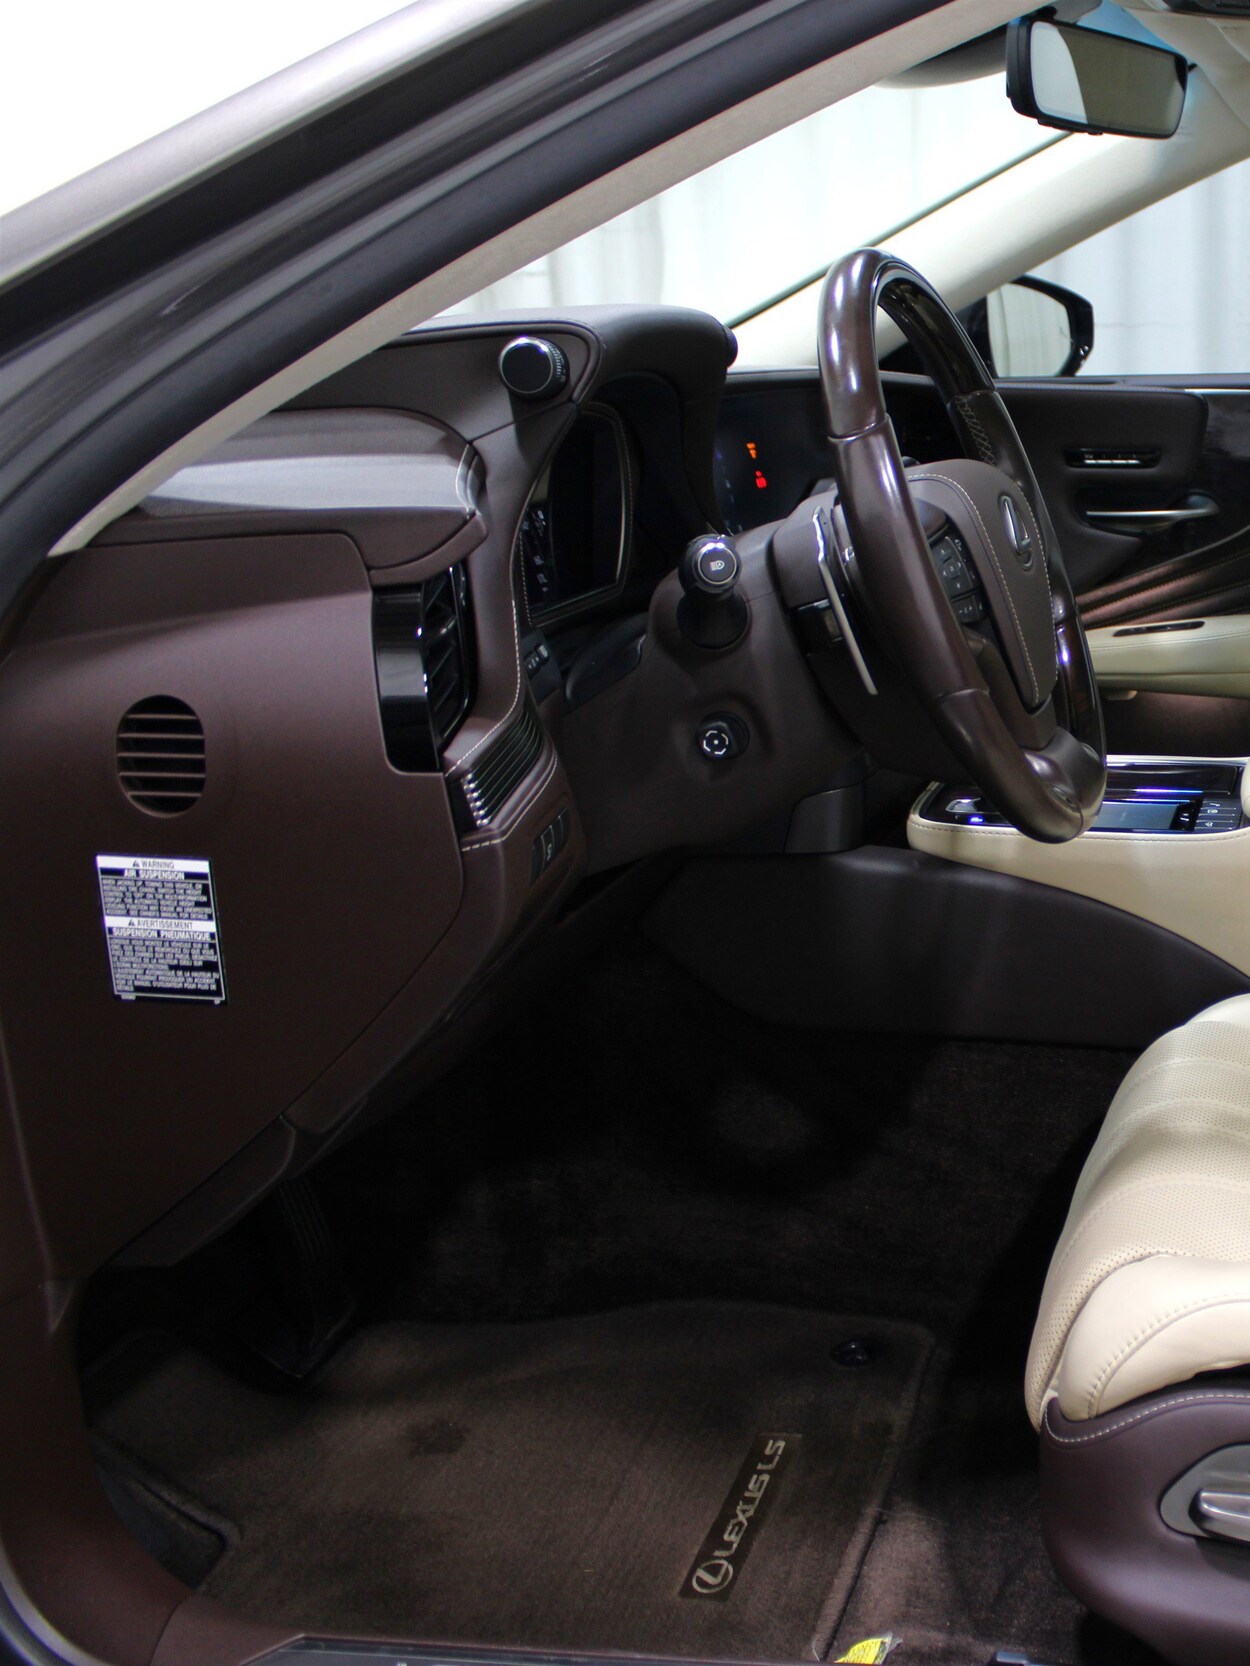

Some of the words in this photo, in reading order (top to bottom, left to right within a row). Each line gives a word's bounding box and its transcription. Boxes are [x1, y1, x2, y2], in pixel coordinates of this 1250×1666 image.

[141, 861, 175, 869] WARNING
[124, 869, 137, 878] AIR
[139, 869, 185, 881] SUSPENSION
[136, 919, 193, 930] AVERTISSEMENT
[112, 928, 158, 939] SUSPENSION
[160, 930, 211, 941] PNEUMATIQUE
[713, 1472, 771, 1557] LEXUS
[756, 1439, 786, 1470] LS
